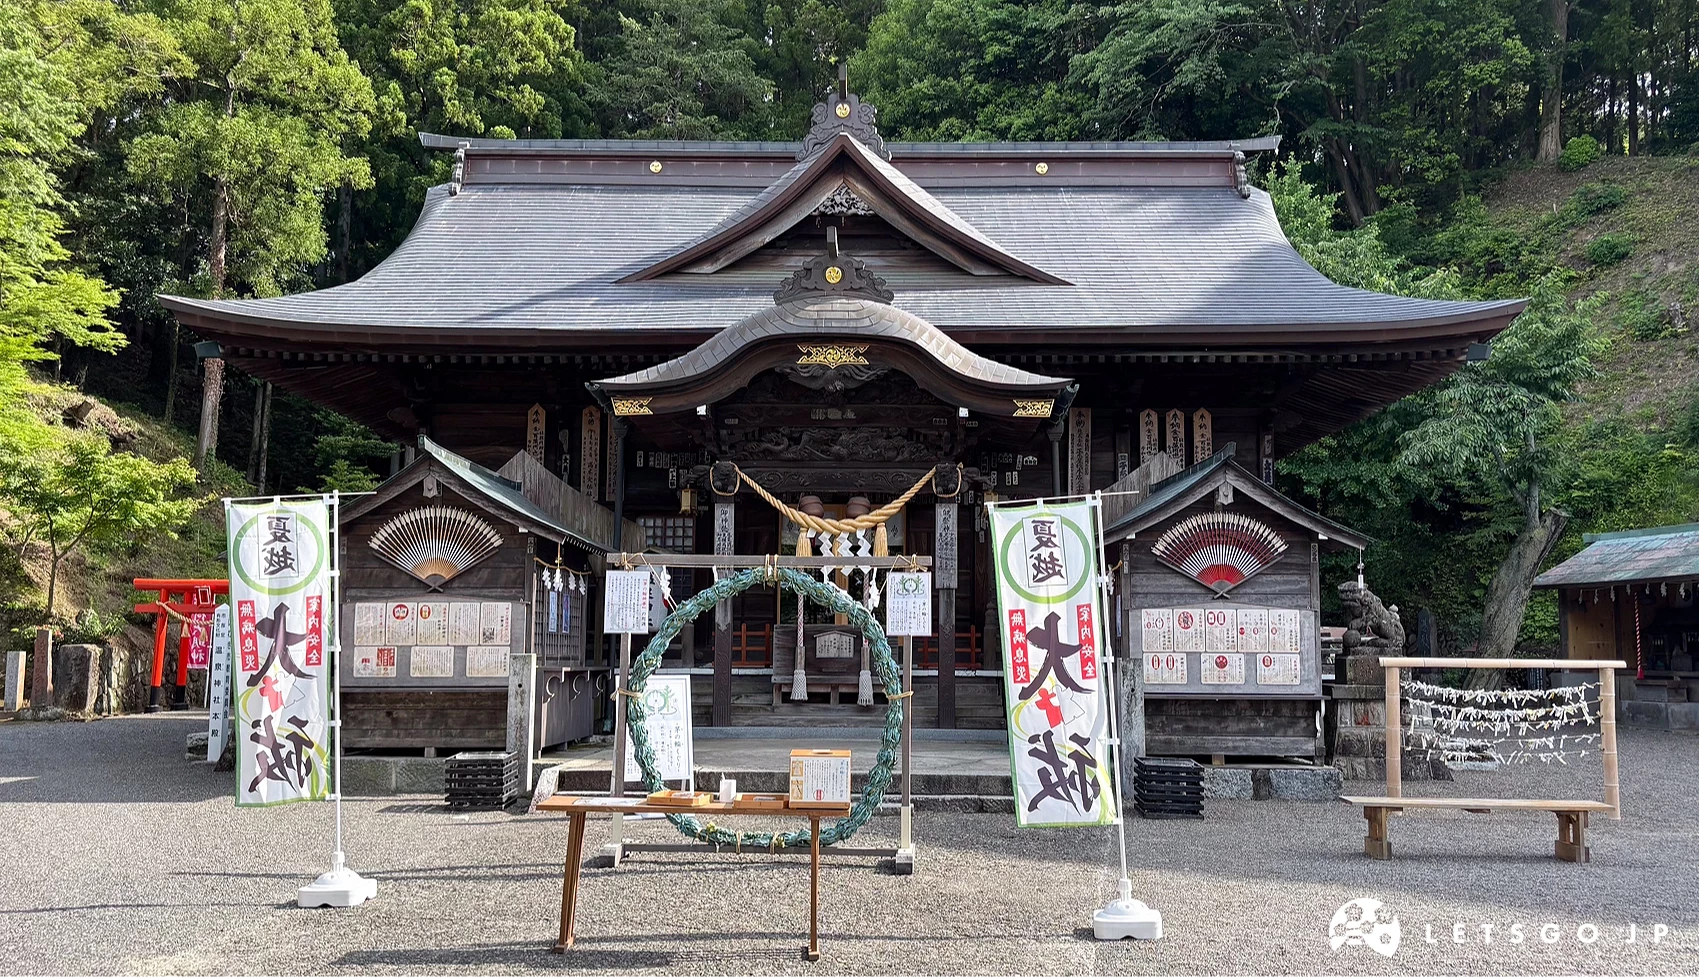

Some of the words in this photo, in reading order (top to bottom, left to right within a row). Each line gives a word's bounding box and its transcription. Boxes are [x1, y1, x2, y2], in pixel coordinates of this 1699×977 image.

[211, 645, 223, 738] 温泉神社本殿
